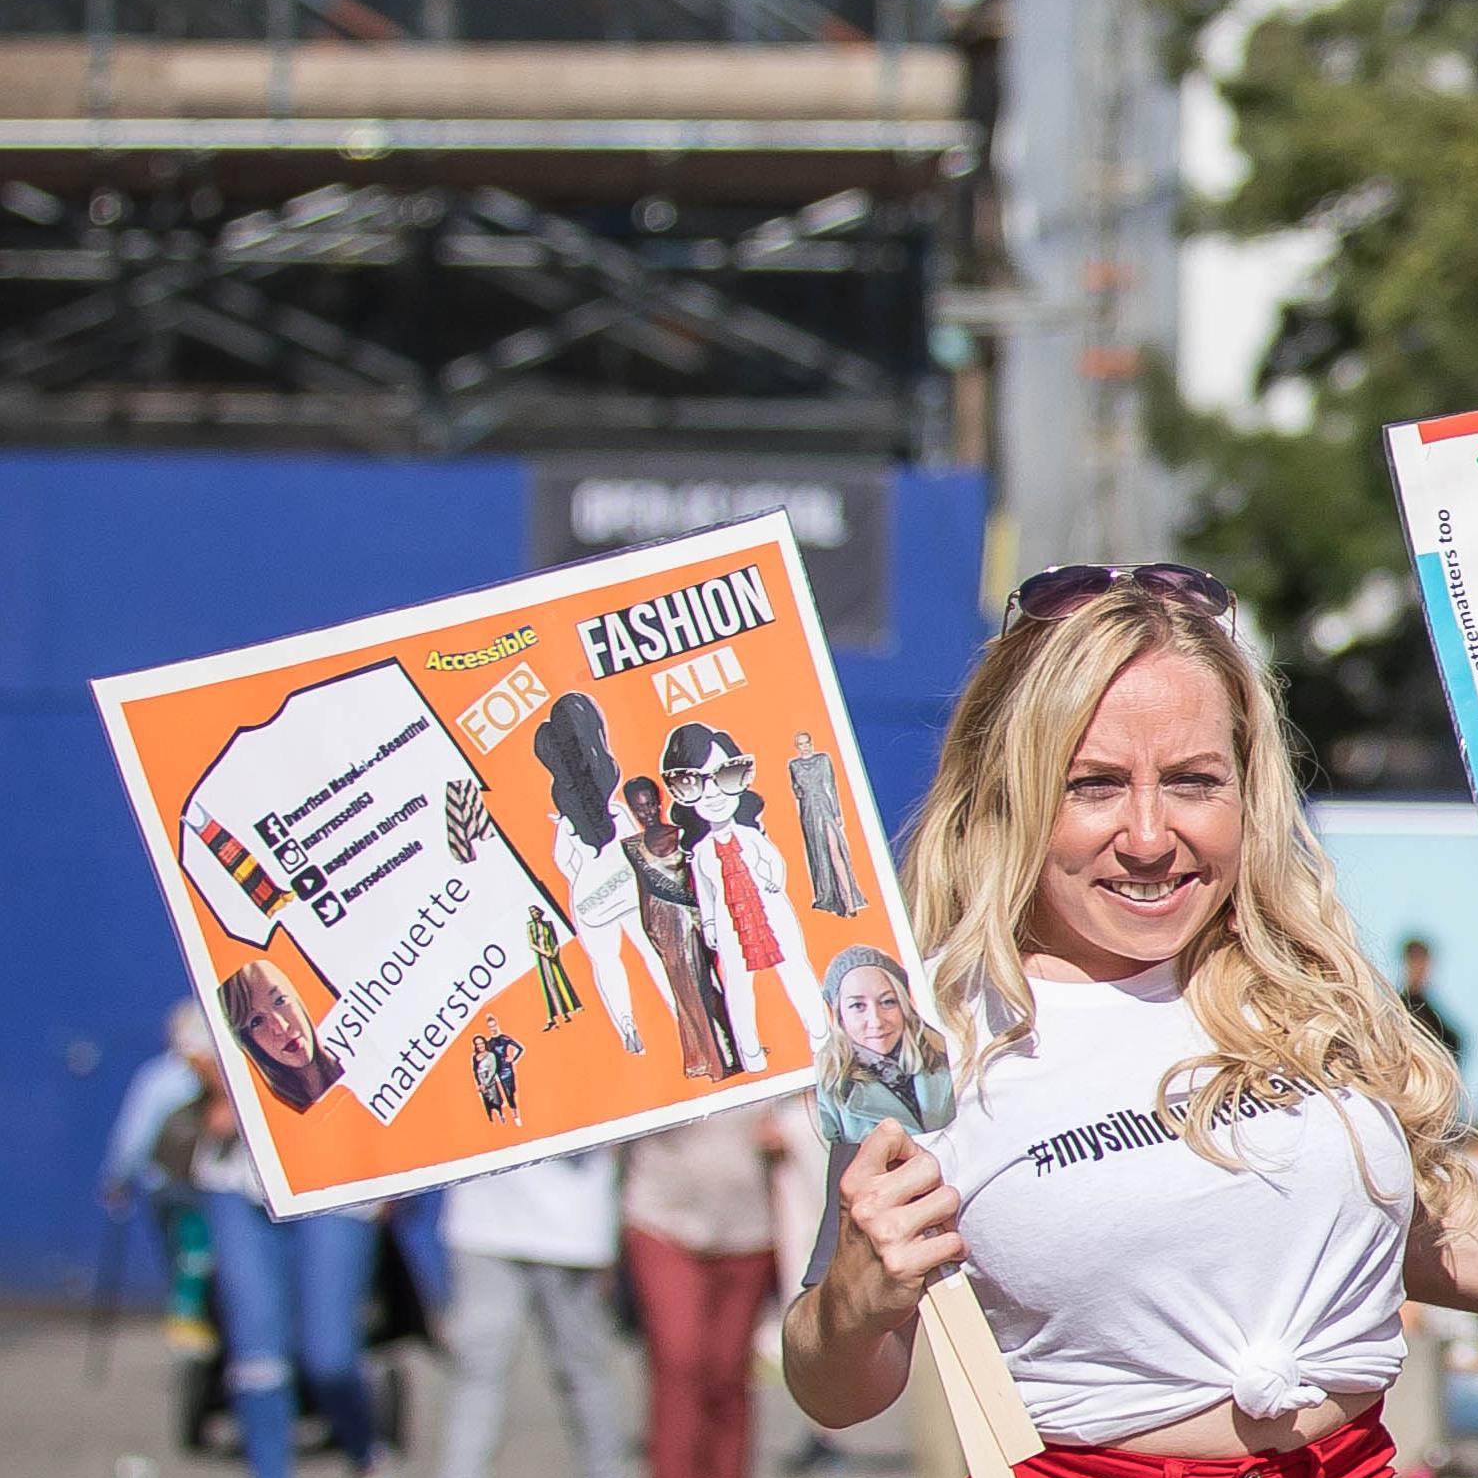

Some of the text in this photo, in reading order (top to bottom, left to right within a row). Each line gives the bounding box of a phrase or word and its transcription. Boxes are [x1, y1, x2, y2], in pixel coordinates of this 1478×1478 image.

[1438, 509, 1452, 544] too
[424, 625, 539, 671] Accessible
[577, 564, 776, 680] FASHION
[460, 654, 746, 752] FOR ALL
[368, 944, 508, 1121] matterstoo
